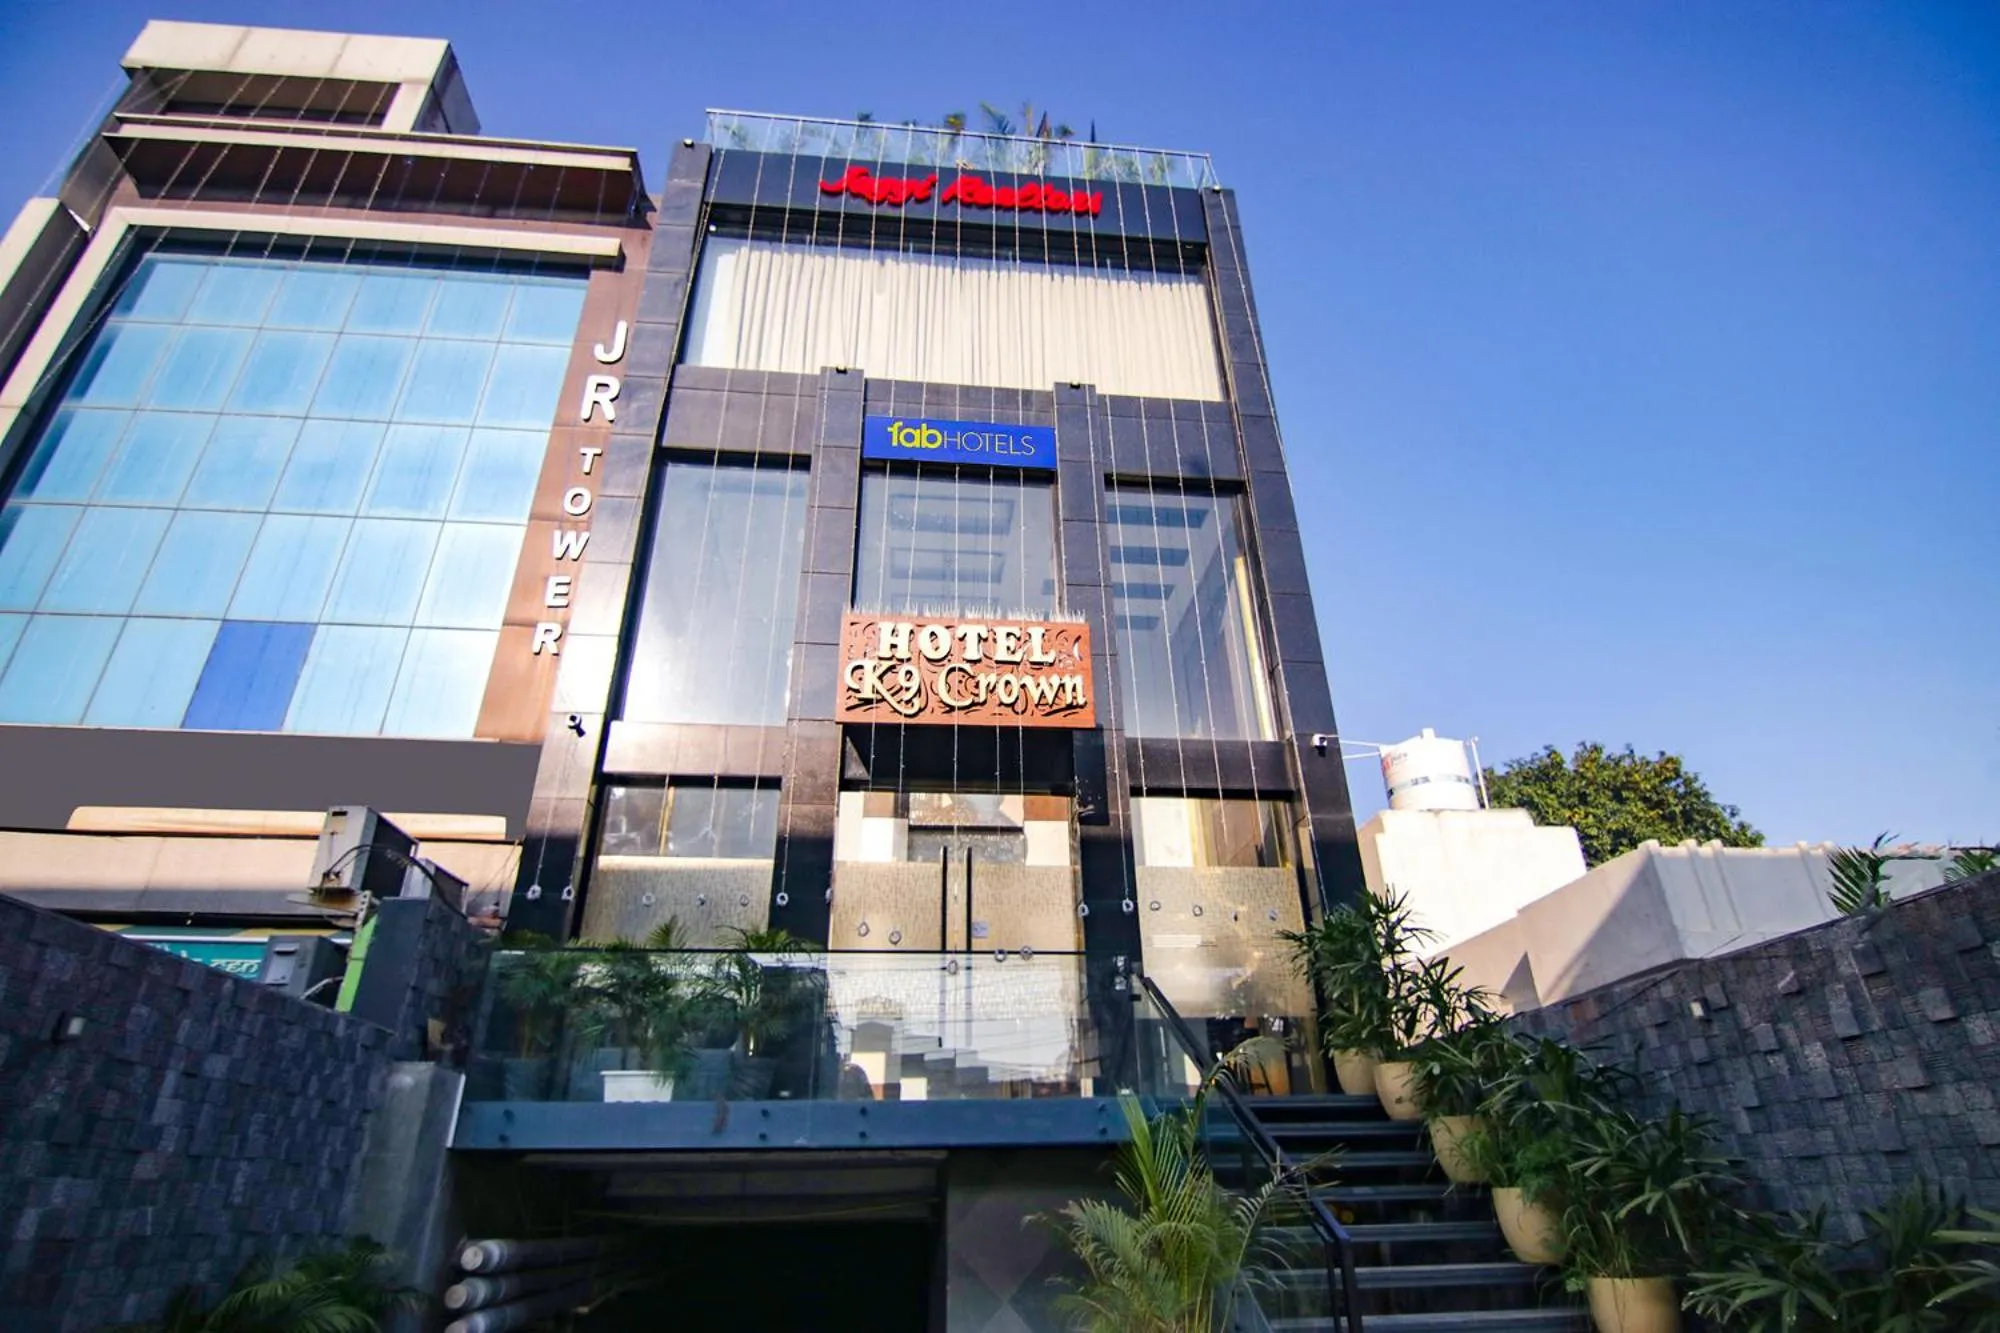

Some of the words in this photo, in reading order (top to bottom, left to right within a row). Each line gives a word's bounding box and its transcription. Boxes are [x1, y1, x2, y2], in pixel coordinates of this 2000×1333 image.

[580, 320, 628, 422] JR
[888, 421, 1036, 456] fabHOTELS
[532, 447, 602, 656] TOWER
[876, 621, 1056, 665] HOTEL
[844, 659, 921, 717] K9
[938, 663, 1087, 707] Crown
